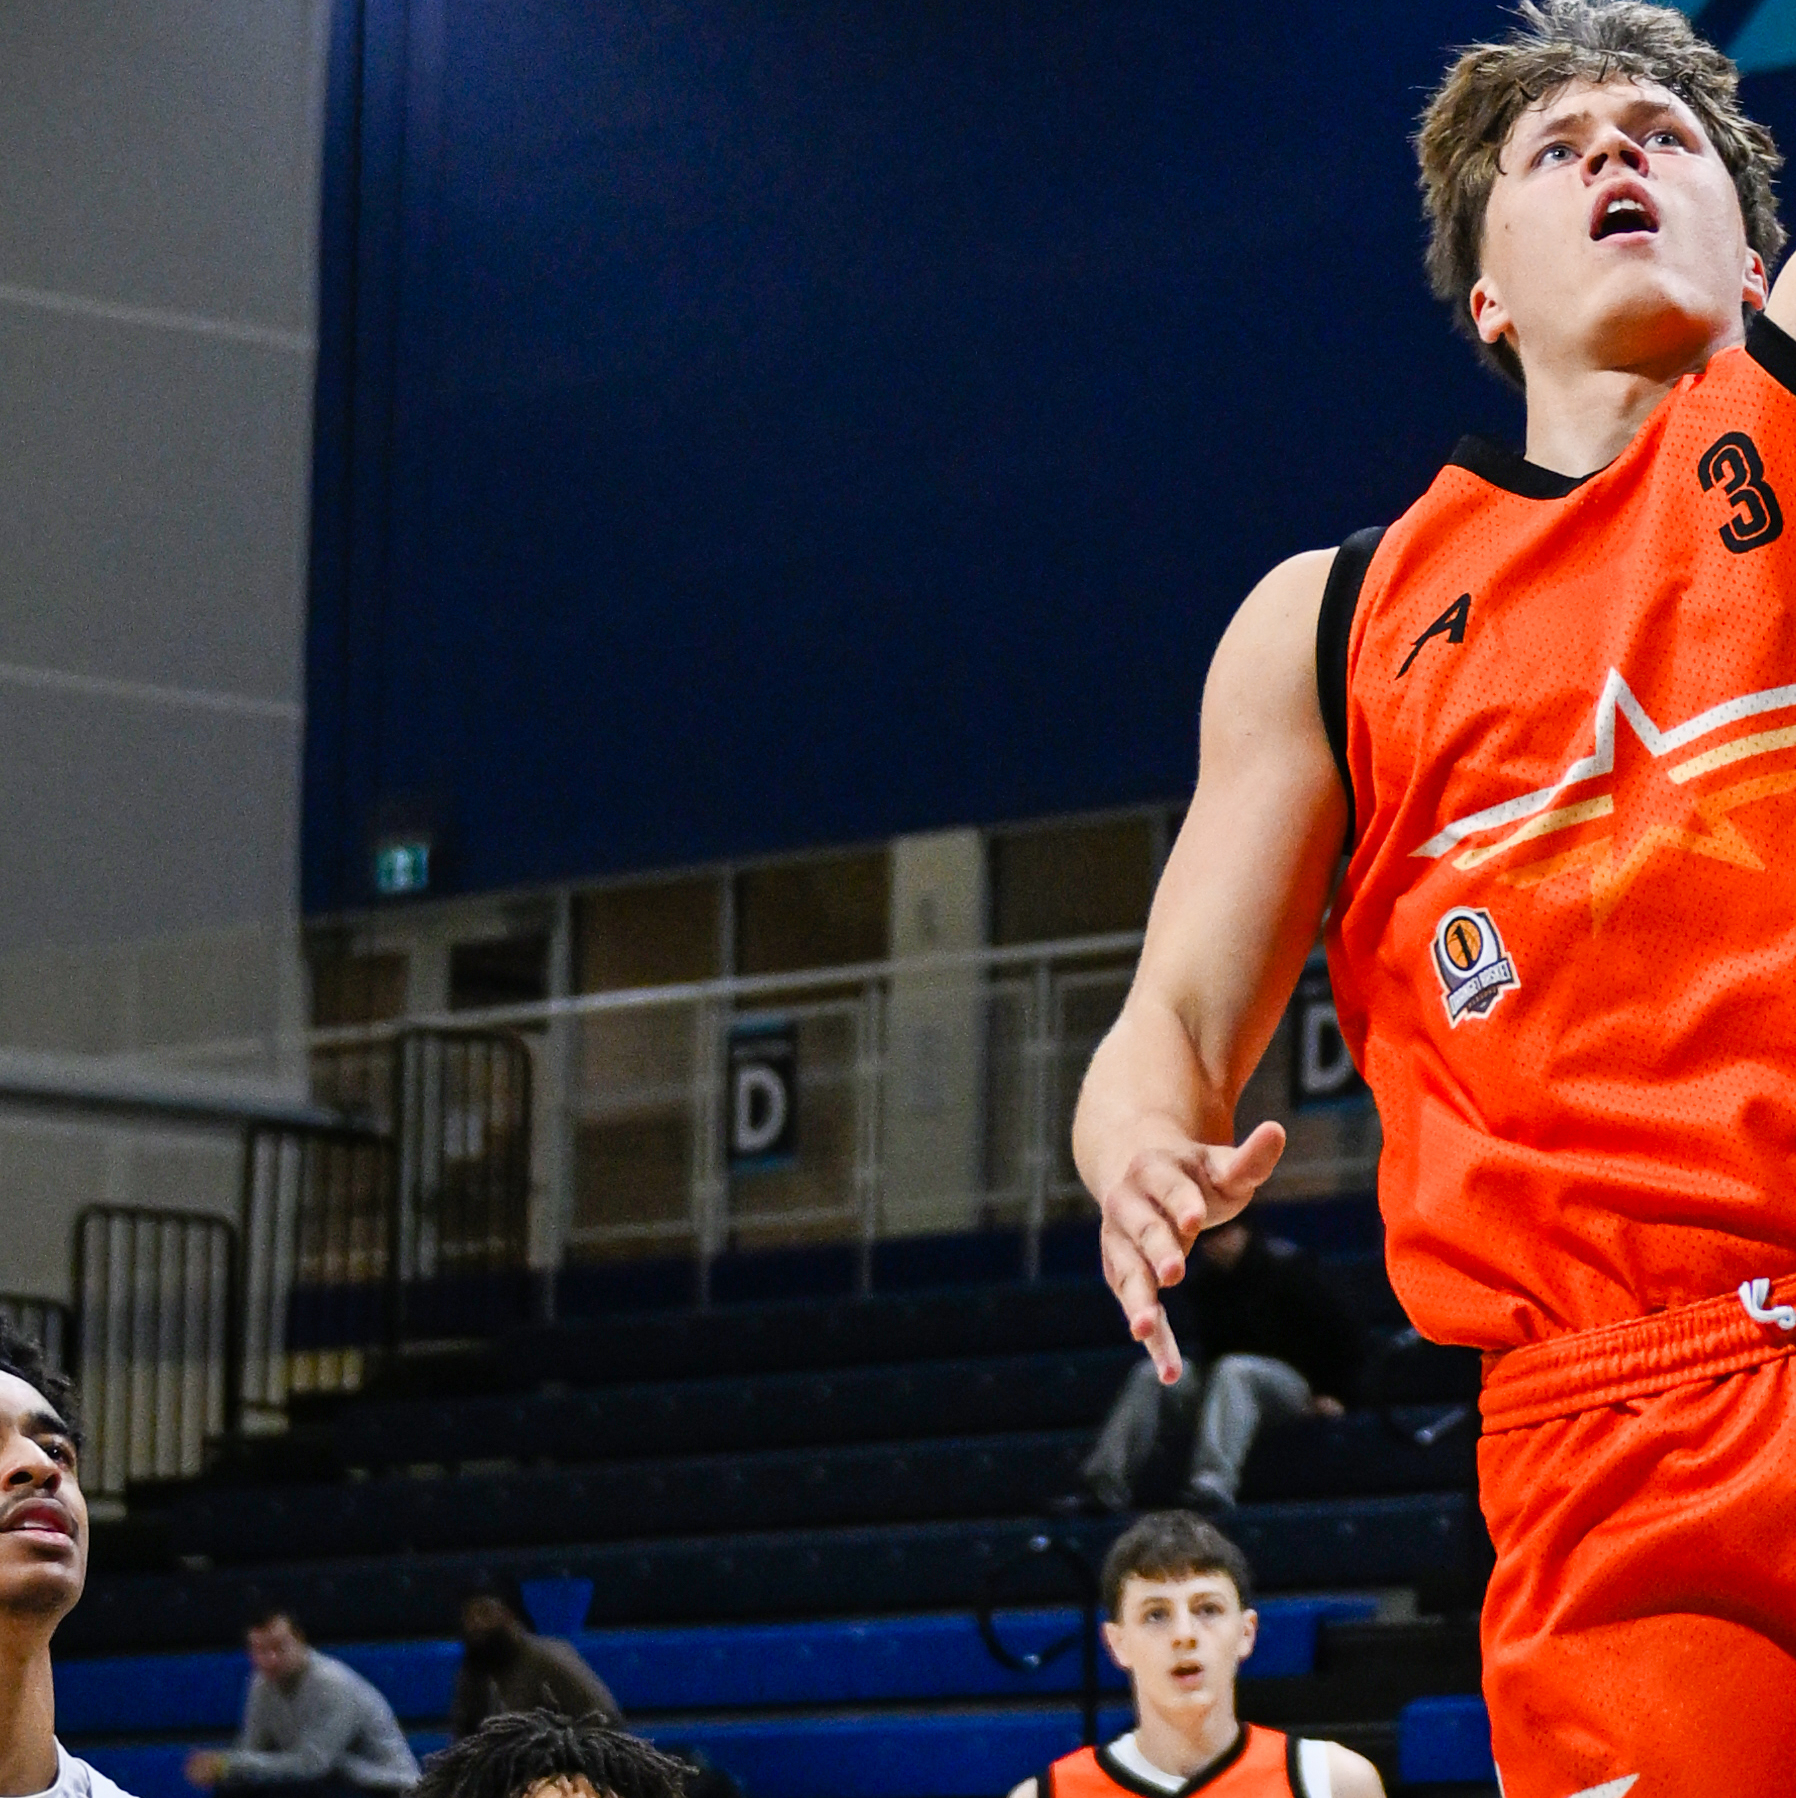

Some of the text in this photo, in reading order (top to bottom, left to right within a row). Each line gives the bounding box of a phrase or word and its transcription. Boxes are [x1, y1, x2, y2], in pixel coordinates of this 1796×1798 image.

[1698, 431, 1784, 554] 3
[1304, 1005, 1355, 1093] D
[733, 1063, 787, 1153] D
